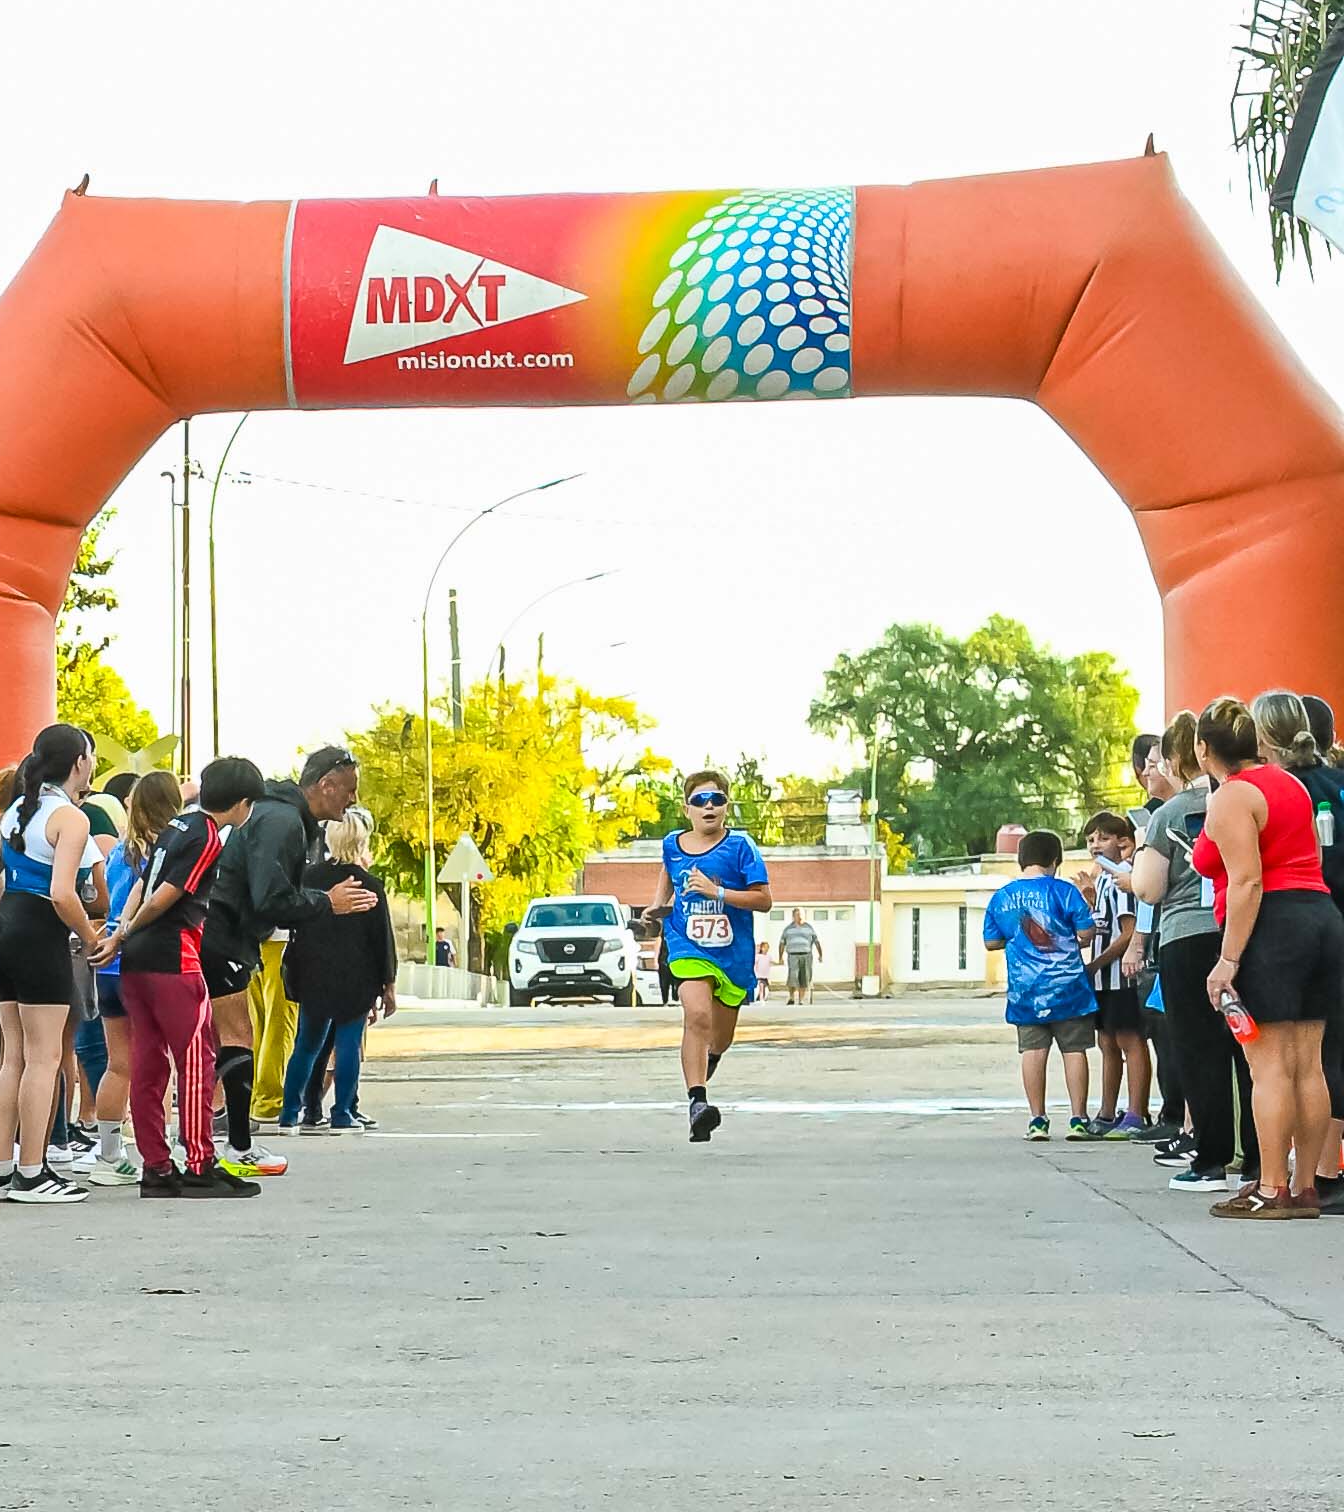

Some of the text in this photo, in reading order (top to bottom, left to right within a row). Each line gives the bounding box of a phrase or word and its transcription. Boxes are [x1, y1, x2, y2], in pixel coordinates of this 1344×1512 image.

[366, 258, 507, 327] MDXT
[397, 350, 574, 370] misiondxt.com
[692, 918, 729, 939] 573
